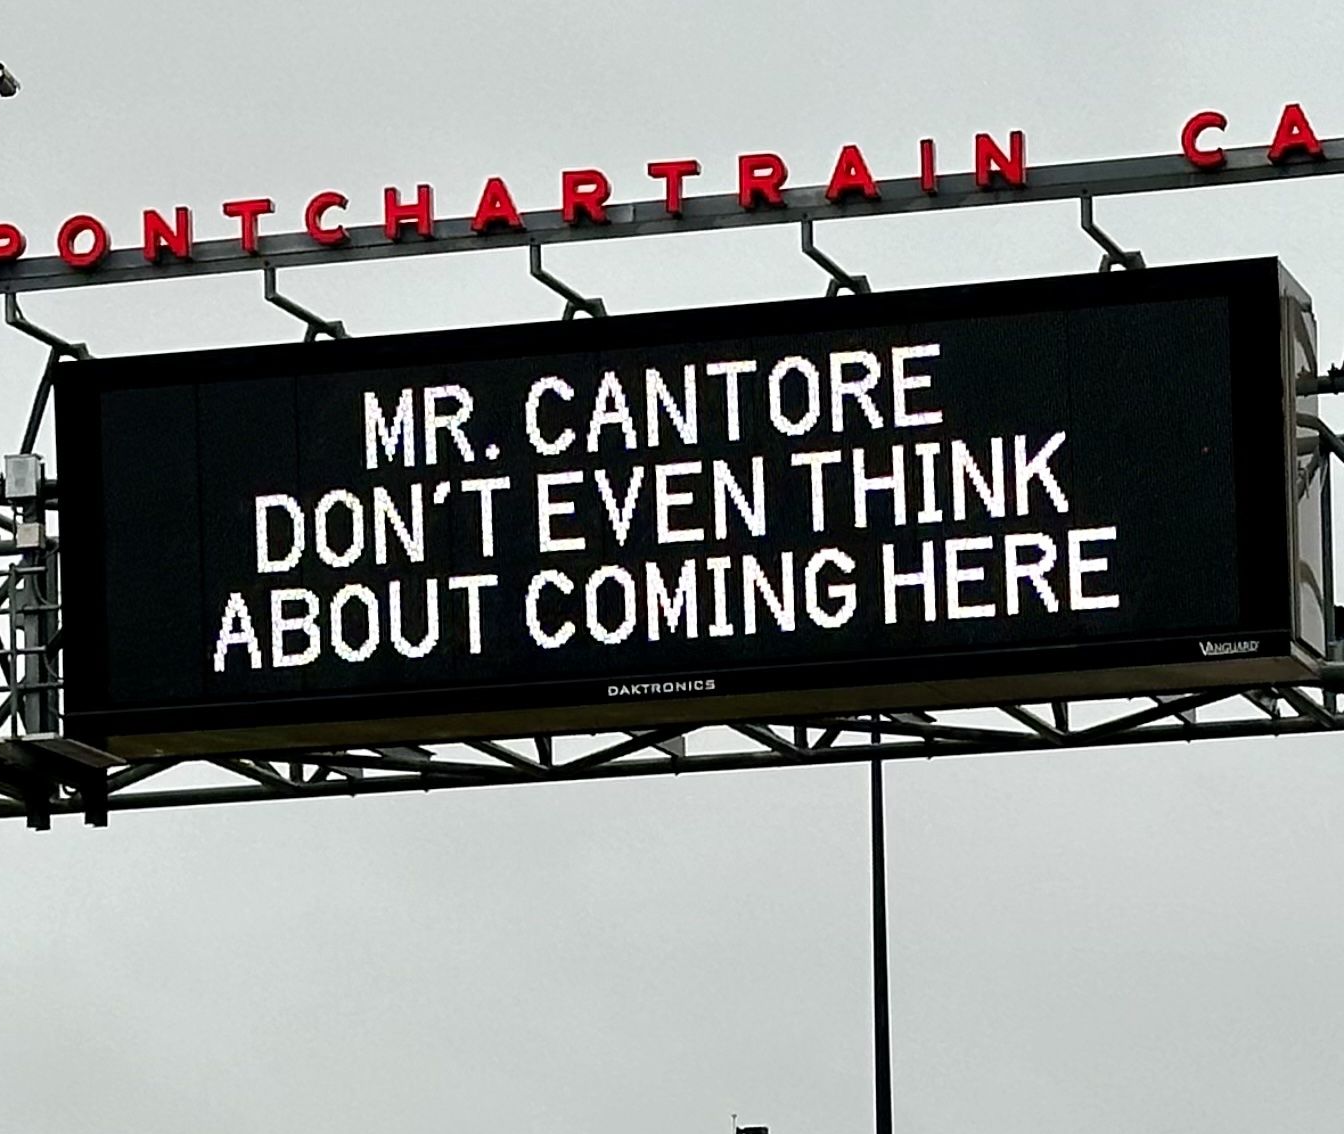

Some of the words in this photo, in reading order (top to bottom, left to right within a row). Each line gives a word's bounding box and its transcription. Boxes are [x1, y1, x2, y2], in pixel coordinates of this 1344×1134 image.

[364, 382, 500, 470] MR.
[525, 343, 944, 456] CANTORE
[255, 476, 511, 574] DON'T
[537, 460, 766, 553] EVEN
[790, 430, 1069, 533] THINK
[213, 574, 499, 673] ABOUT
[525, 540, 858, 649] COMING
[882, 525, 1120, 625] HERE
[607, 679, 716, 697] DAKTRONICS
